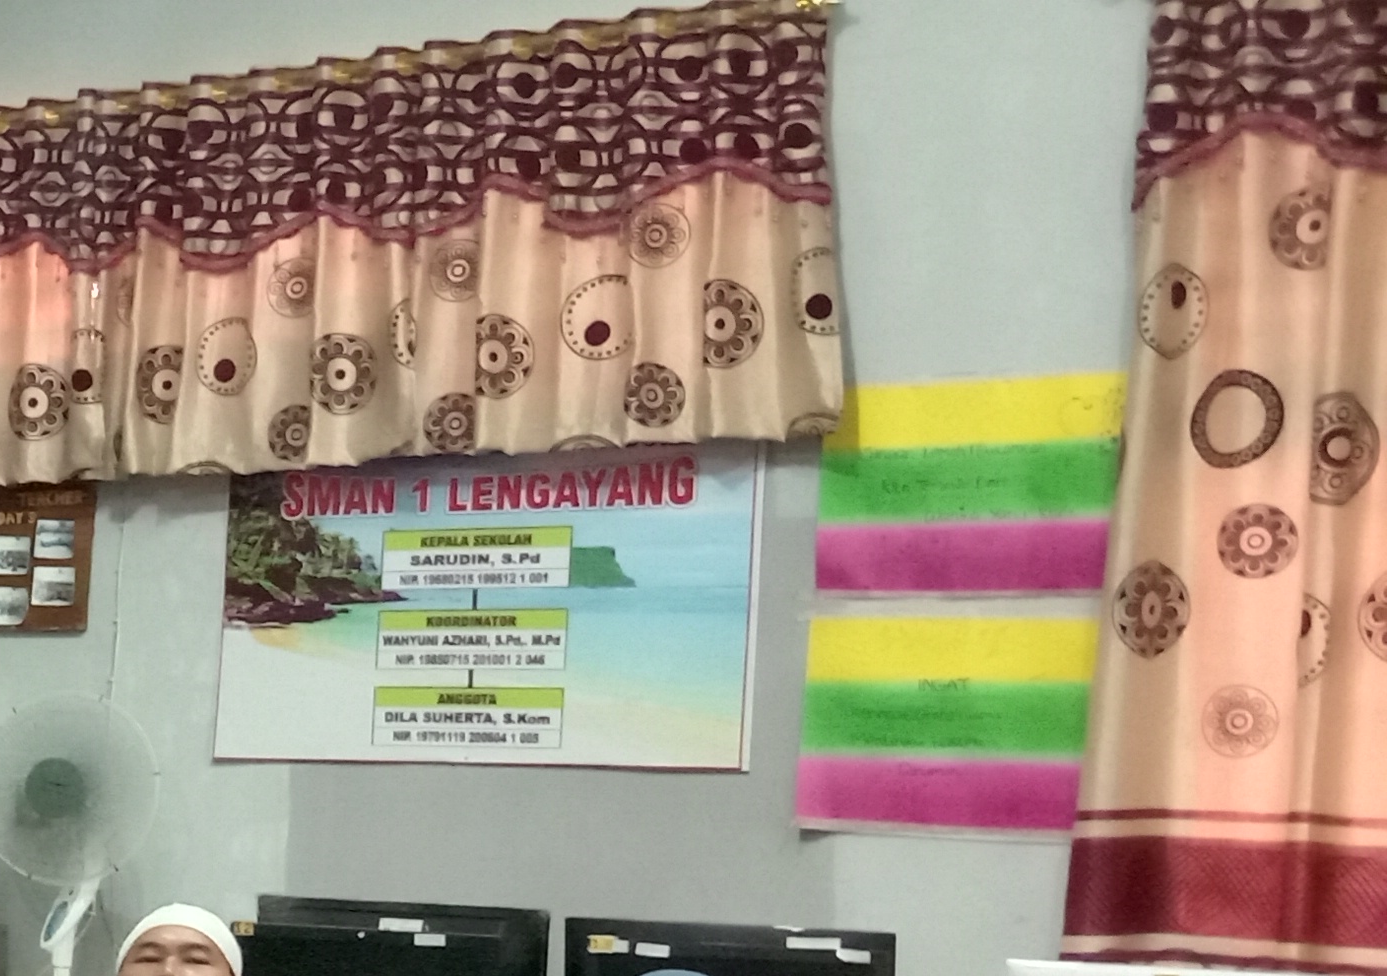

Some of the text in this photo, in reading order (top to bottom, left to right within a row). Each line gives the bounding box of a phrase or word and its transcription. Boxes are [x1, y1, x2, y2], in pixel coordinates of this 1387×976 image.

[281, 454, 698, 521] SMAN 1 LENGAYANG
[420, 534, 533, 548] KEPALA SEKOLAH
[410, 553, 540, 567] SARUDIN, S.Pd
[426, 616, 517, 627] KOORDINATOR
[384, 712, 418, 724] DILA
[503, 713, 551, 725] S.Kom
